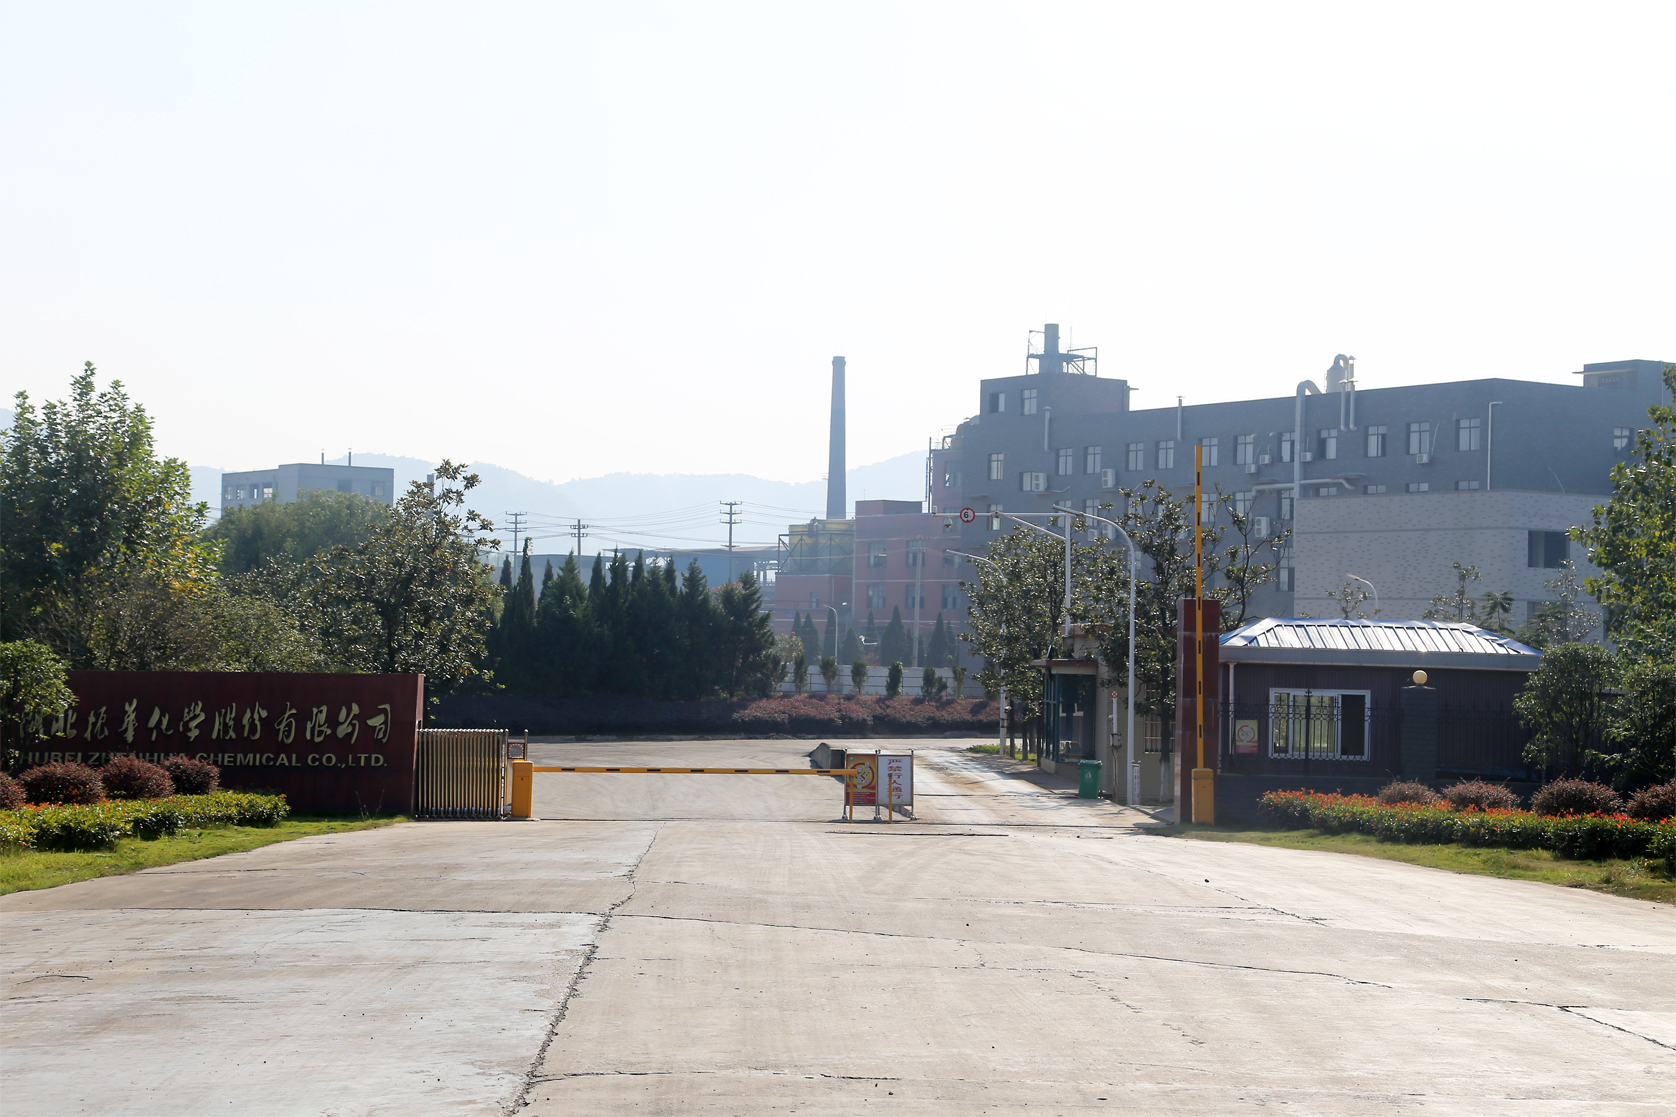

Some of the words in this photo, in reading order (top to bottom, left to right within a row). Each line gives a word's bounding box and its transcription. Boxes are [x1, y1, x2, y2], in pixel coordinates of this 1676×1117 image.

[19, 752, 82, 765] HUBEI
[87, 752, 187, 765] ZHNHU
[195, 752, 302, 766] CHEMICAL
